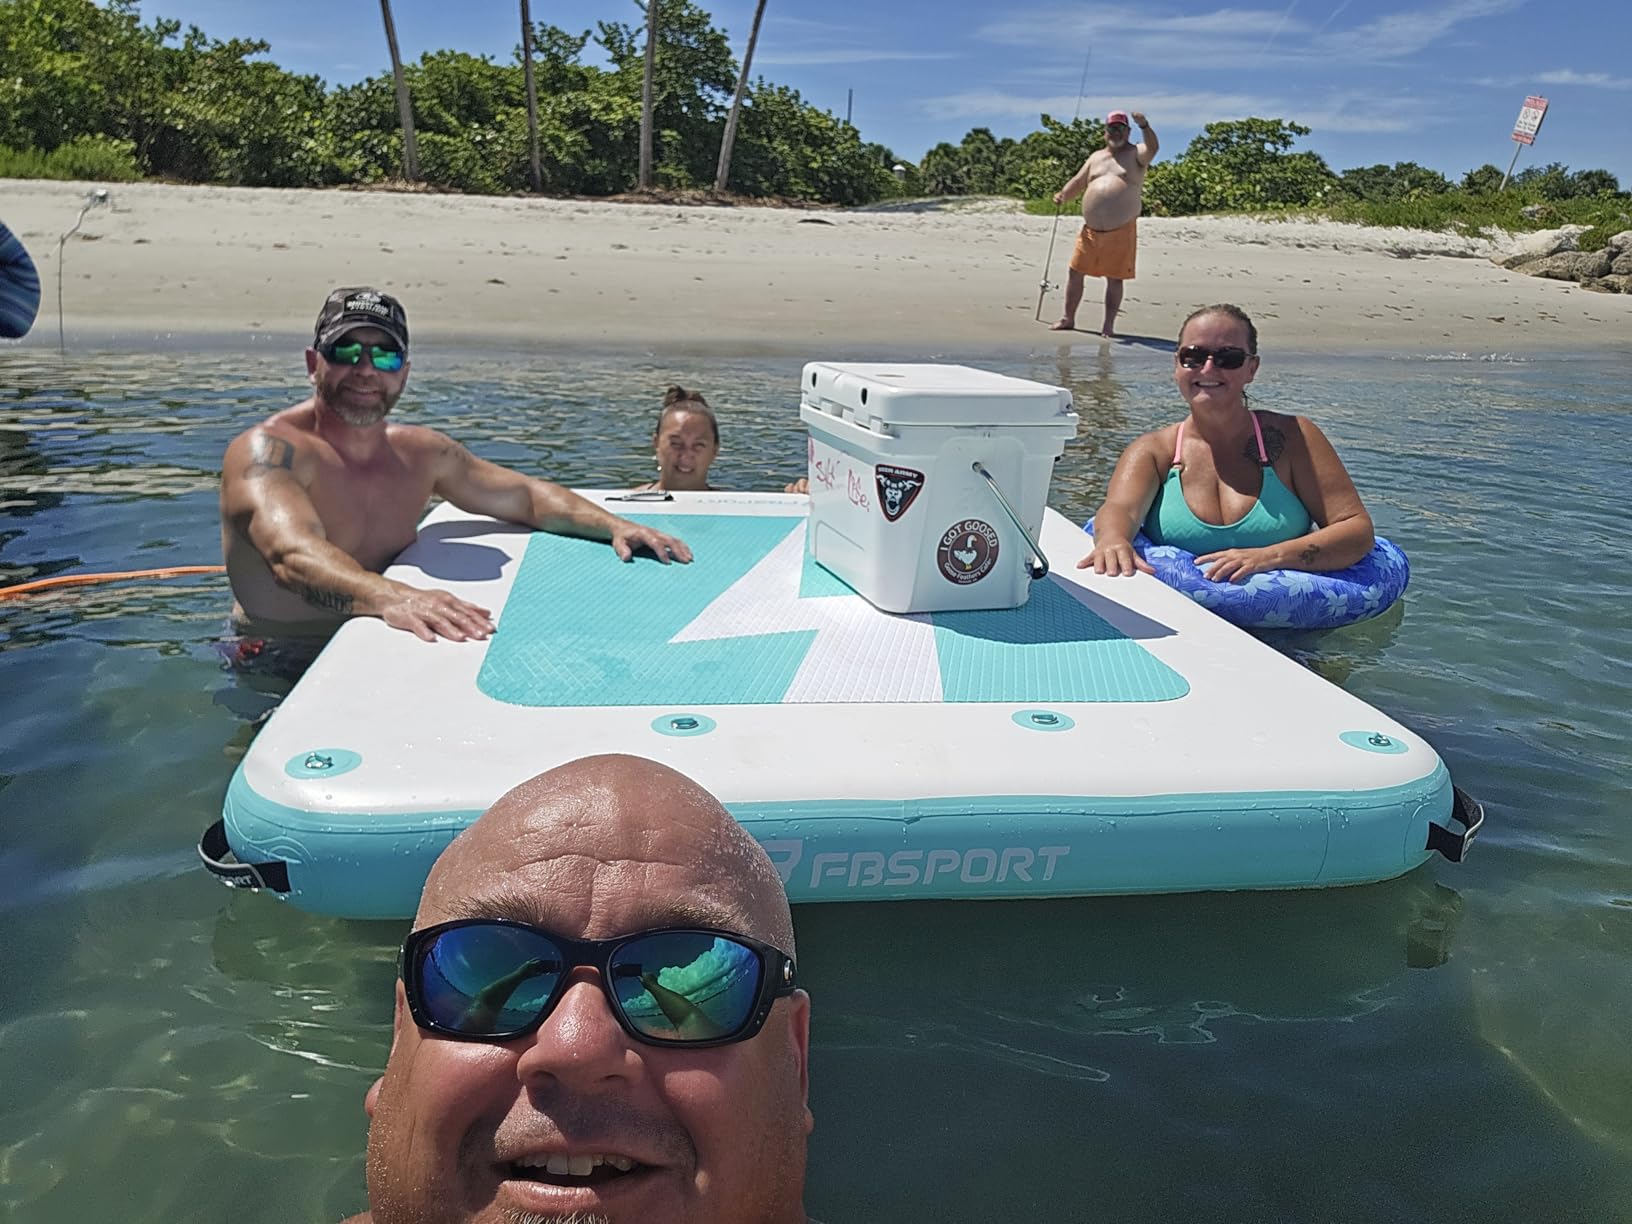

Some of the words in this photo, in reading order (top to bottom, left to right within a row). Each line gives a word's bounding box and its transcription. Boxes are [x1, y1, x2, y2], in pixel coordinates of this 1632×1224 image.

[894, 468, 919, 479] ARMY
[943, 523, 963, 547] GOT
[964, 520, 998, 548] GOOSED
[809, 846, 1071, 889] FBSPORT
